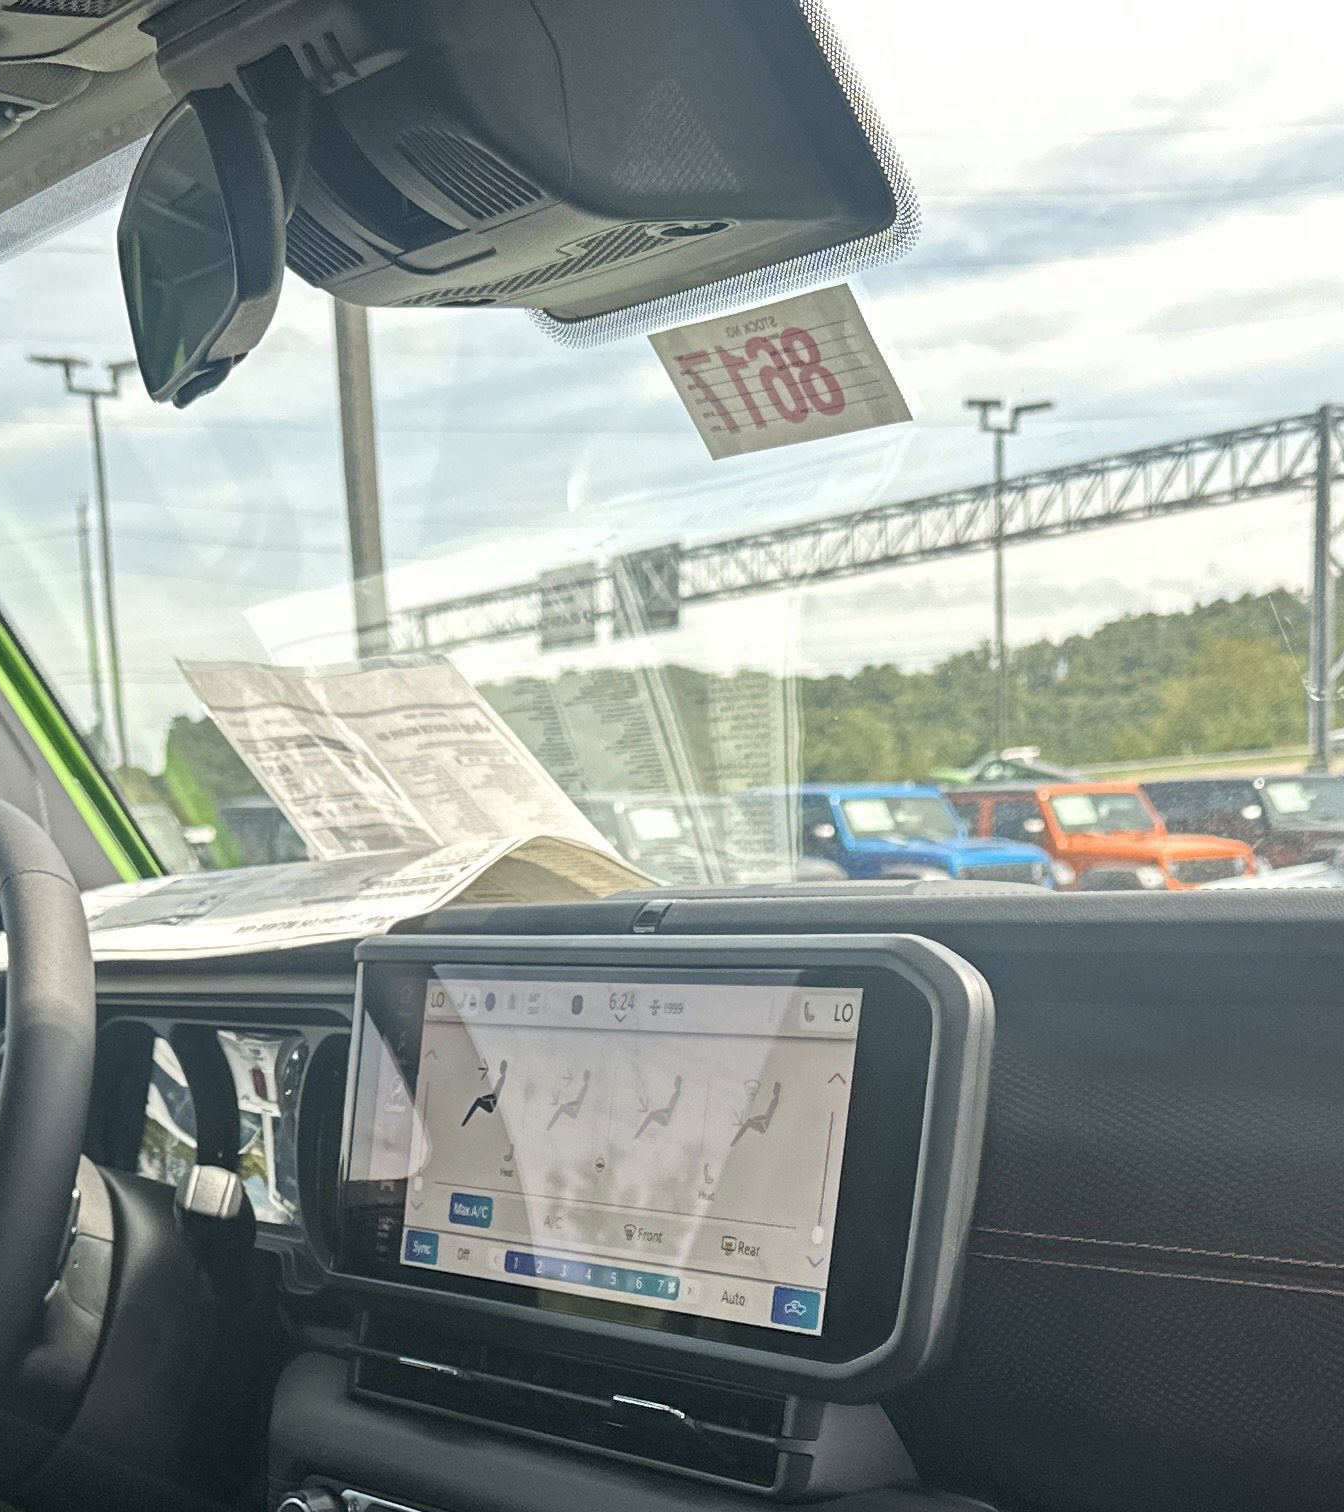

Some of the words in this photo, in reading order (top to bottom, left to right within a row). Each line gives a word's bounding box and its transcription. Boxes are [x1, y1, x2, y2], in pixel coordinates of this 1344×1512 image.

[834, 1003, 854, 1022] LO
[638, 1227, 663, 1244] Front
[413, 1240, 431, 1256] Sync
[737, 1241, 760, 1257] Rear
[536, 1260, 543, 1274] 2
[560, 1265, 567, 1278] 3
[610, 1272, 617, 1285] 5
[635, 1276, 643, 1289] 6
[721, 1290, 746, 1306] Auto
